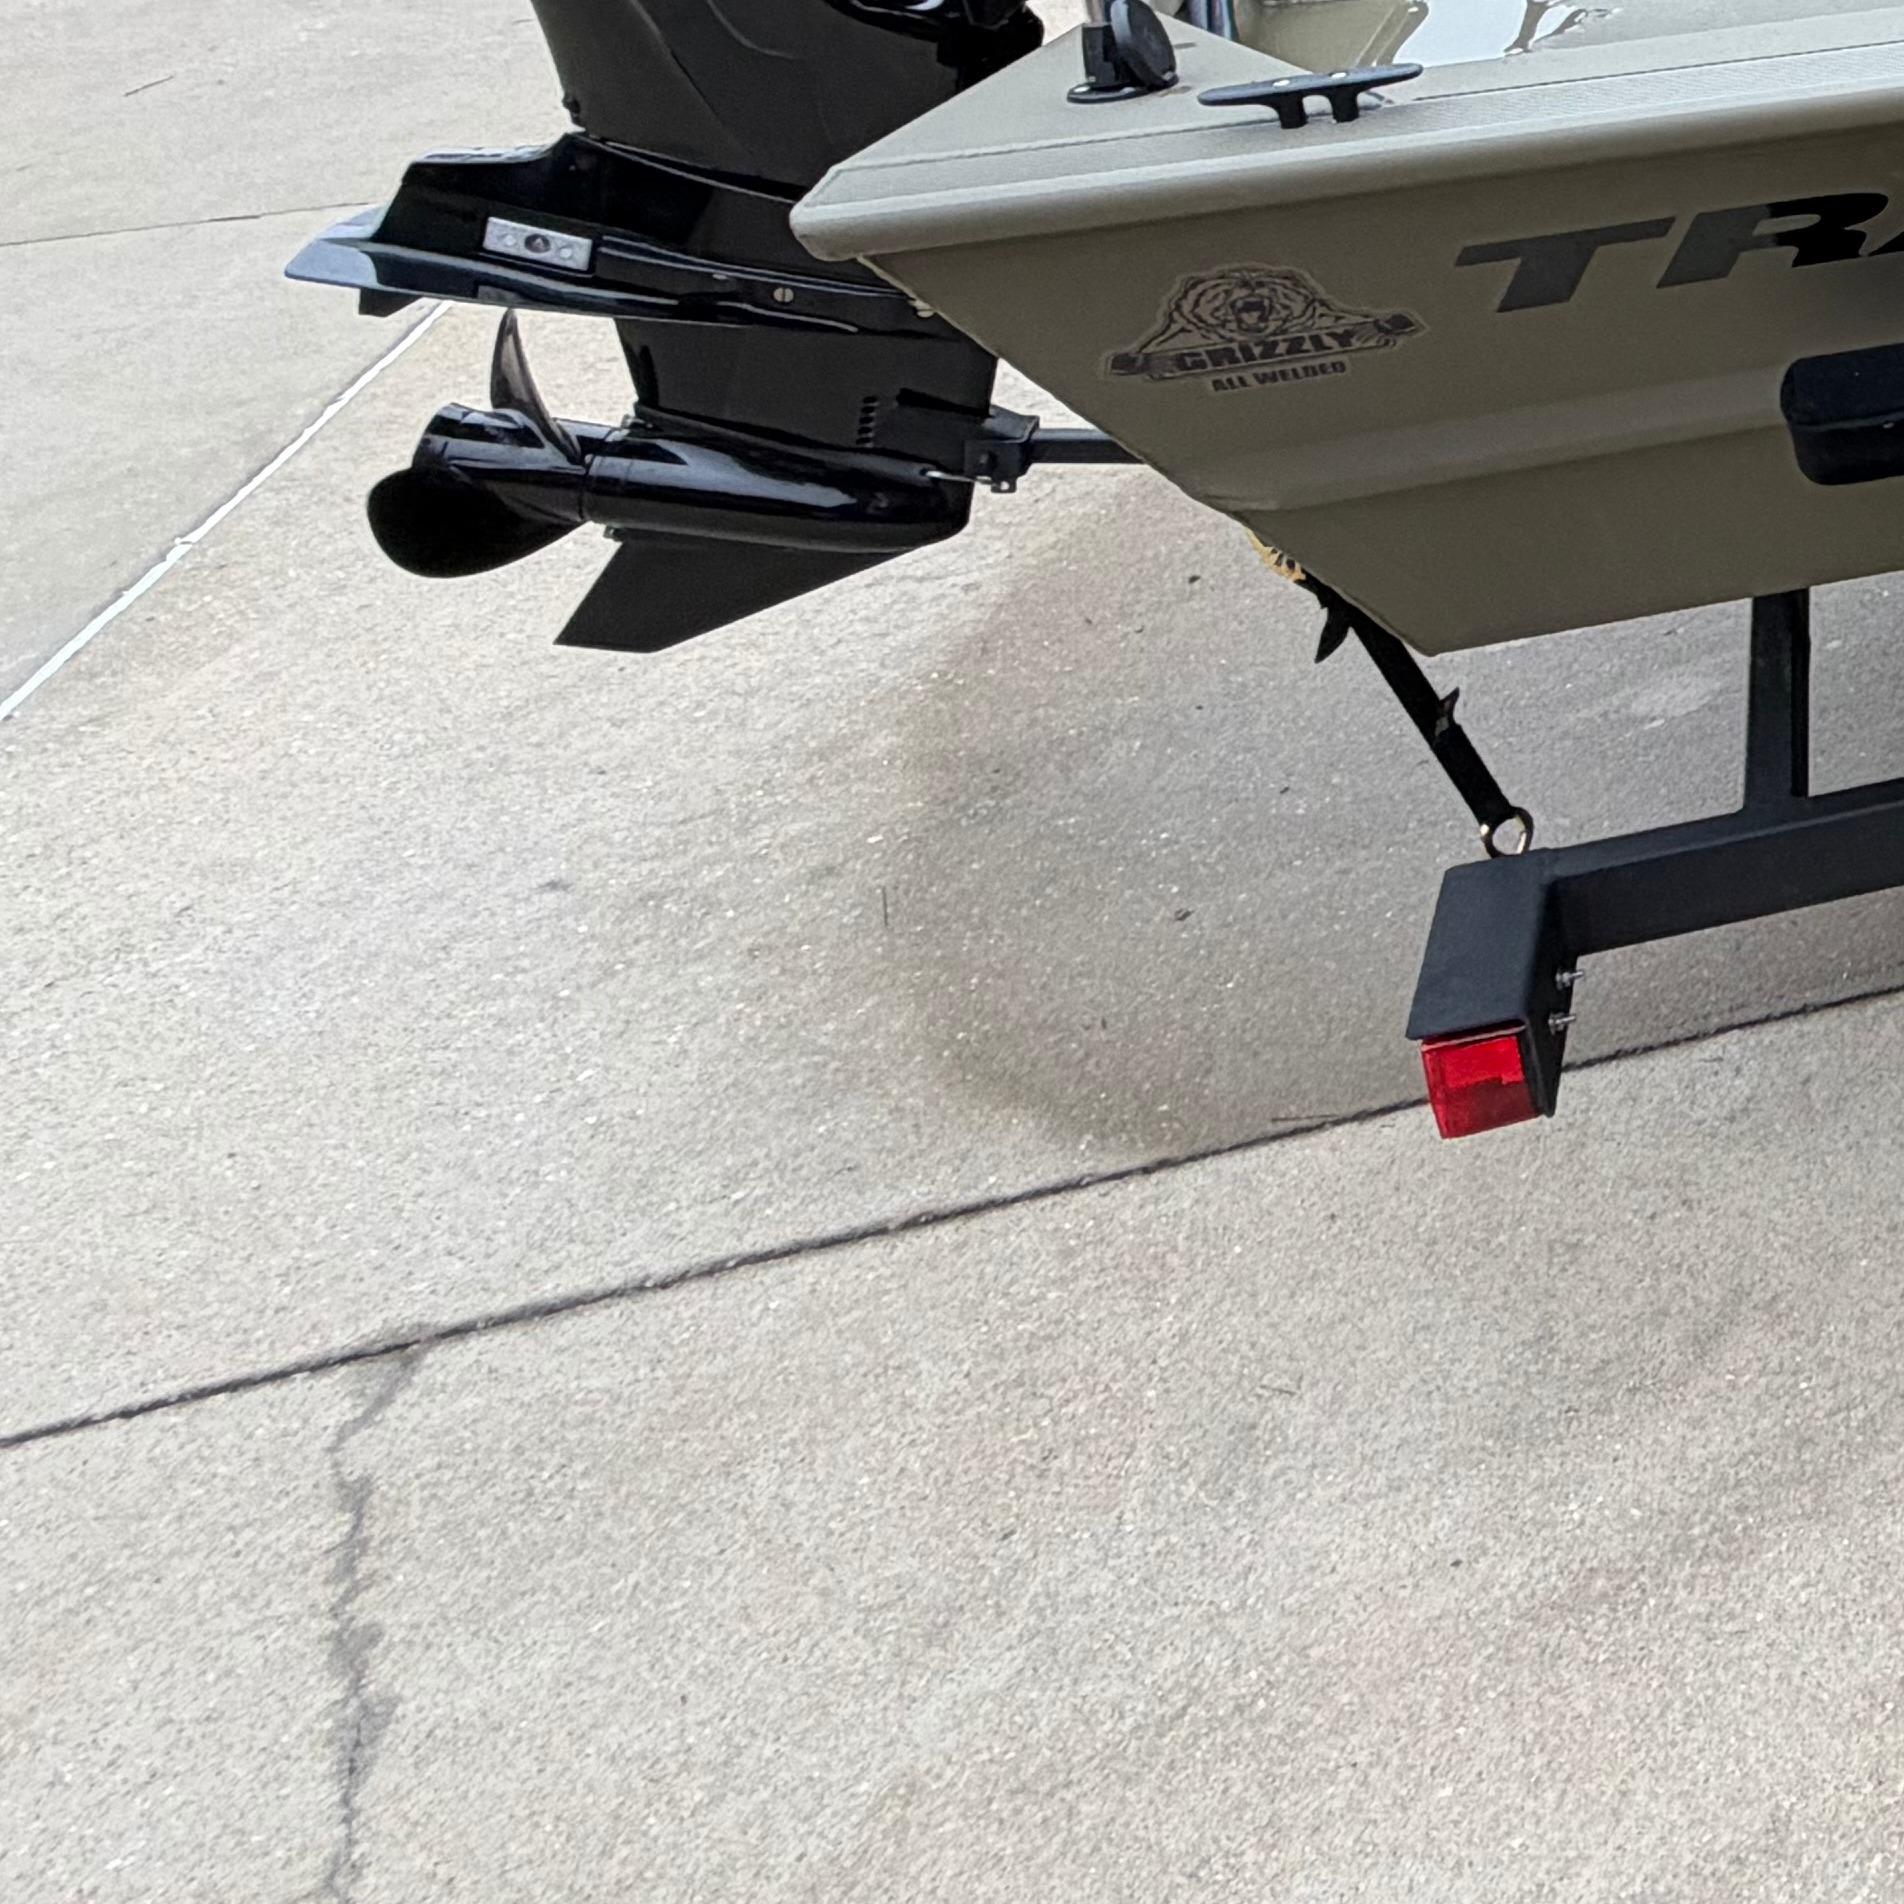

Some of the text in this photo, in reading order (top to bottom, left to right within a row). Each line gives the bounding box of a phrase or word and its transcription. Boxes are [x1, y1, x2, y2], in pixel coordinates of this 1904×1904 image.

[1176, 328, 1357, 371] GRIZZLY
[1212, 361, 1347, 392] ALL WELDED
